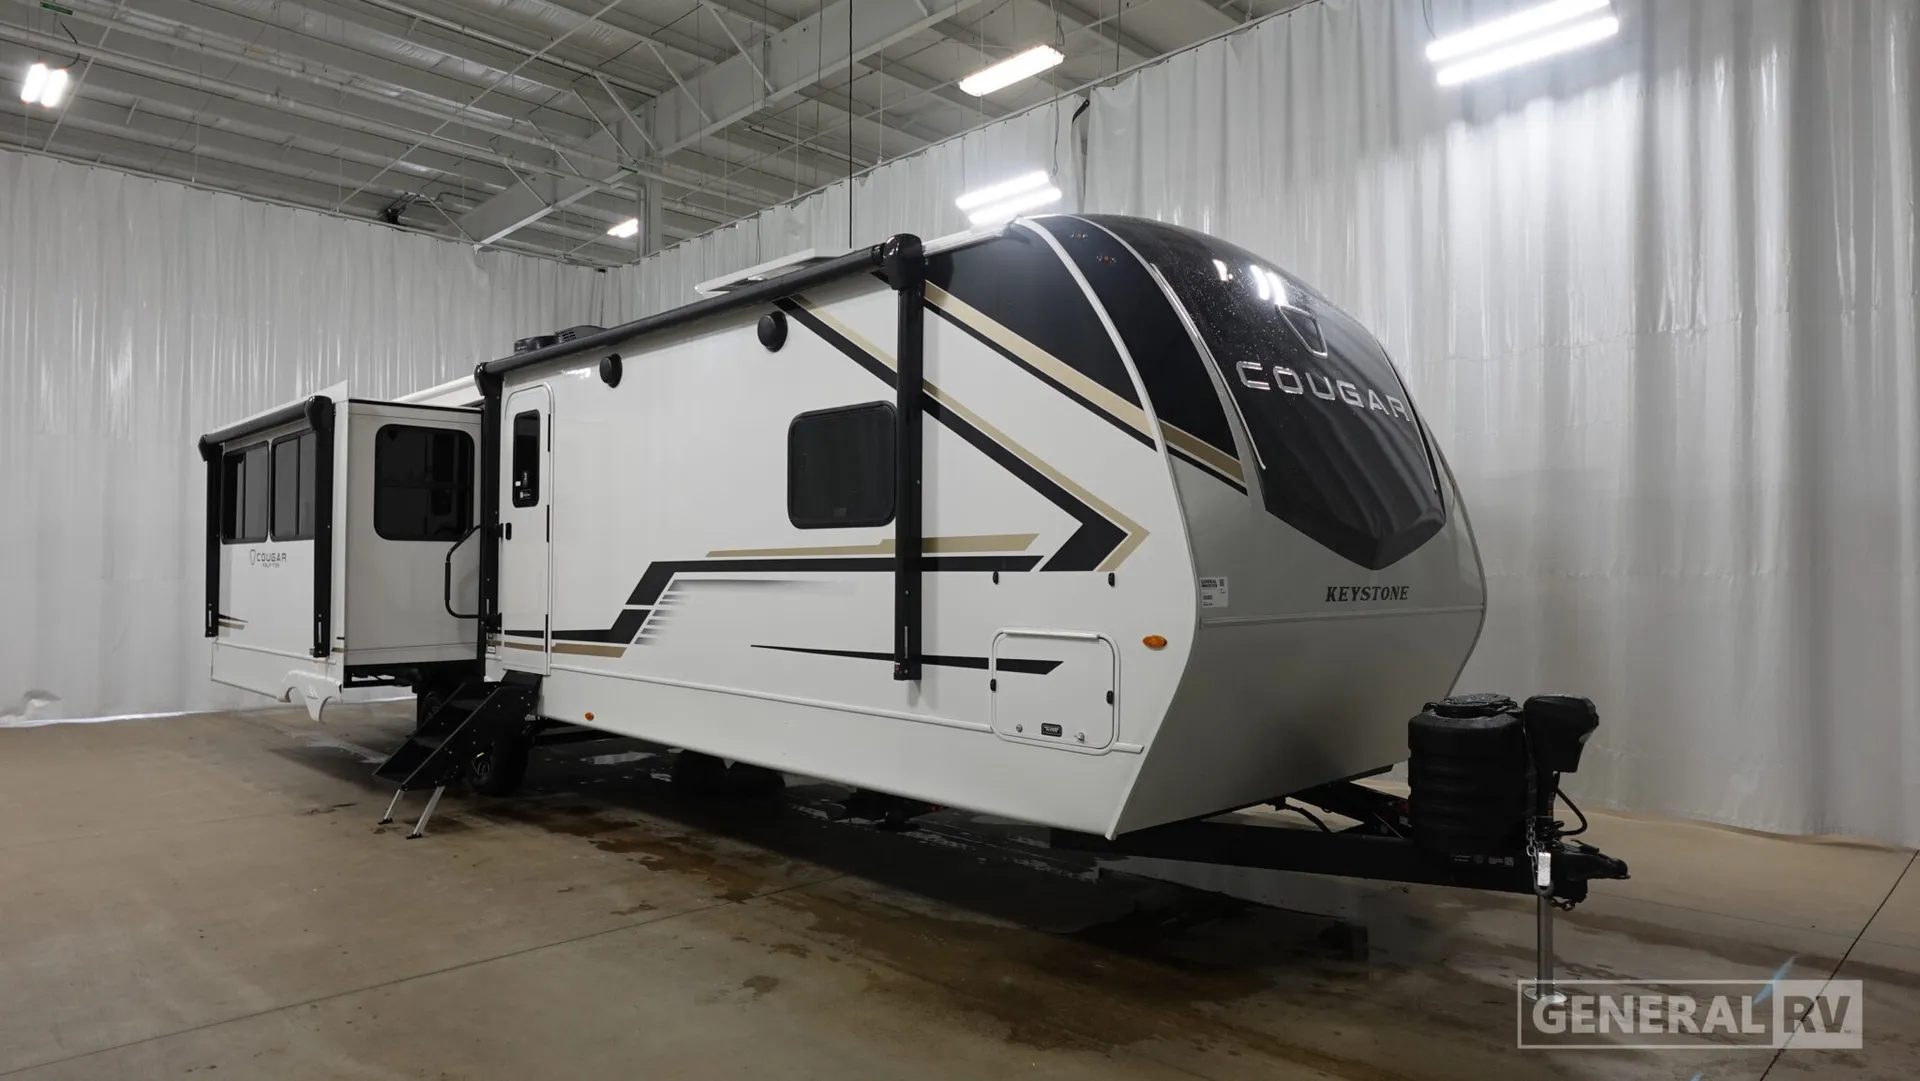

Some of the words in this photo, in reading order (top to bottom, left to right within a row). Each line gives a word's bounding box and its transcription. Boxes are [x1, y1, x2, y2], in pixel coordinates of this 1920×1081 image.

[1236, 361, 1410, 422] COUGAR
[256, 552, 287, 562] COUGAR
[1325, 586, 1410, 602] KEYSTONE
